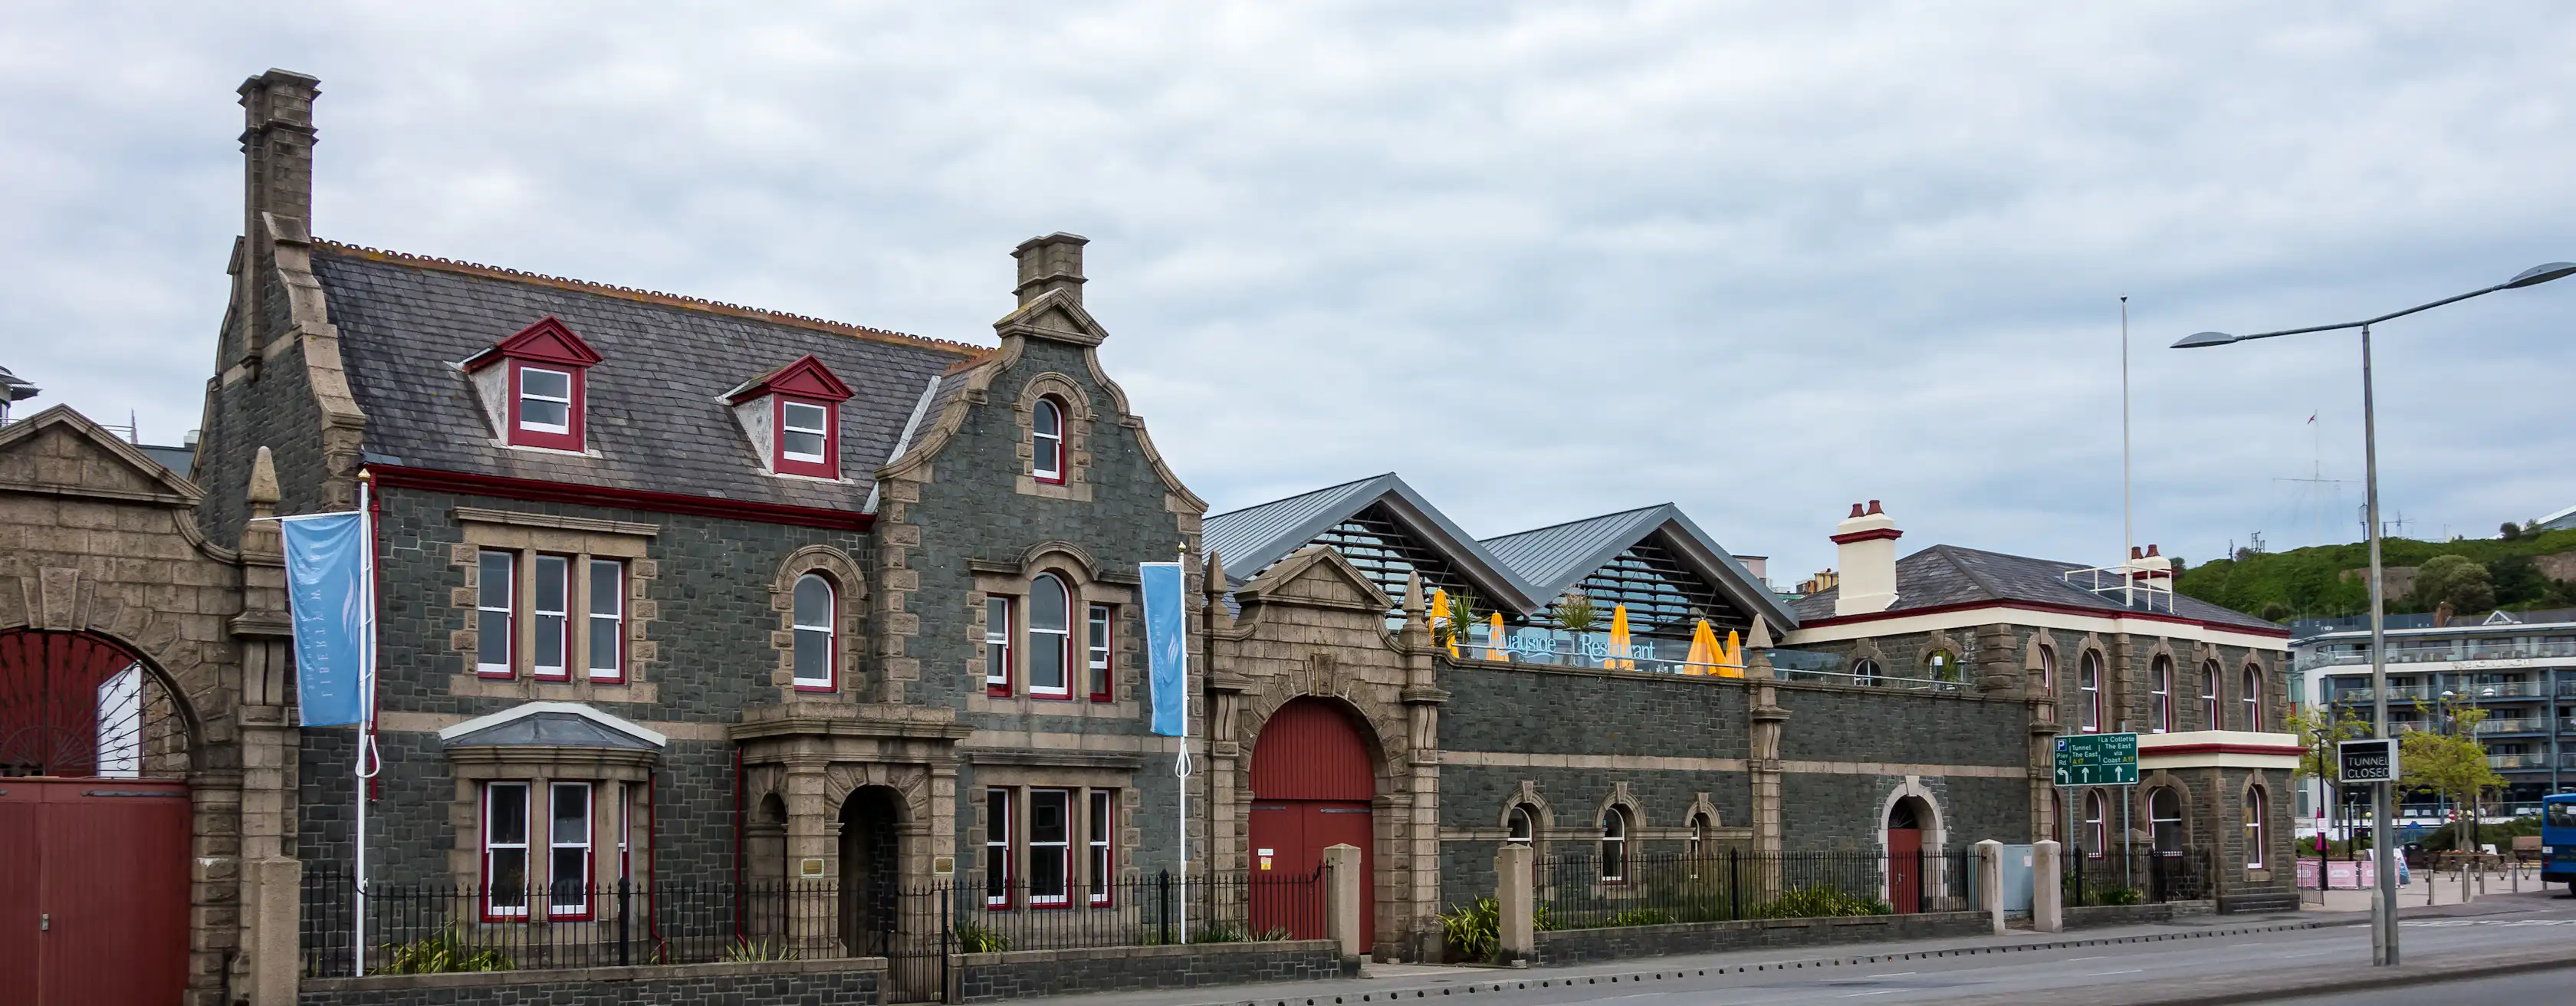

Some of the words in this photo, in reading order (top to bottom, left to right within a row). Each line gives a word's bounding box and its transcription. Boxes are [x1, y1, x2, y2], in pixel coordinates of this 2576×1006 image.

[1488, 626, 1556, 657] Quayside
[1579, 634, 1656, 662] Restaurant
[2057, 740, 2065, 751] P
[2348, 756, 2389, 767] TUNNEL
[2348, 768, 2389, 779] CLOSED
